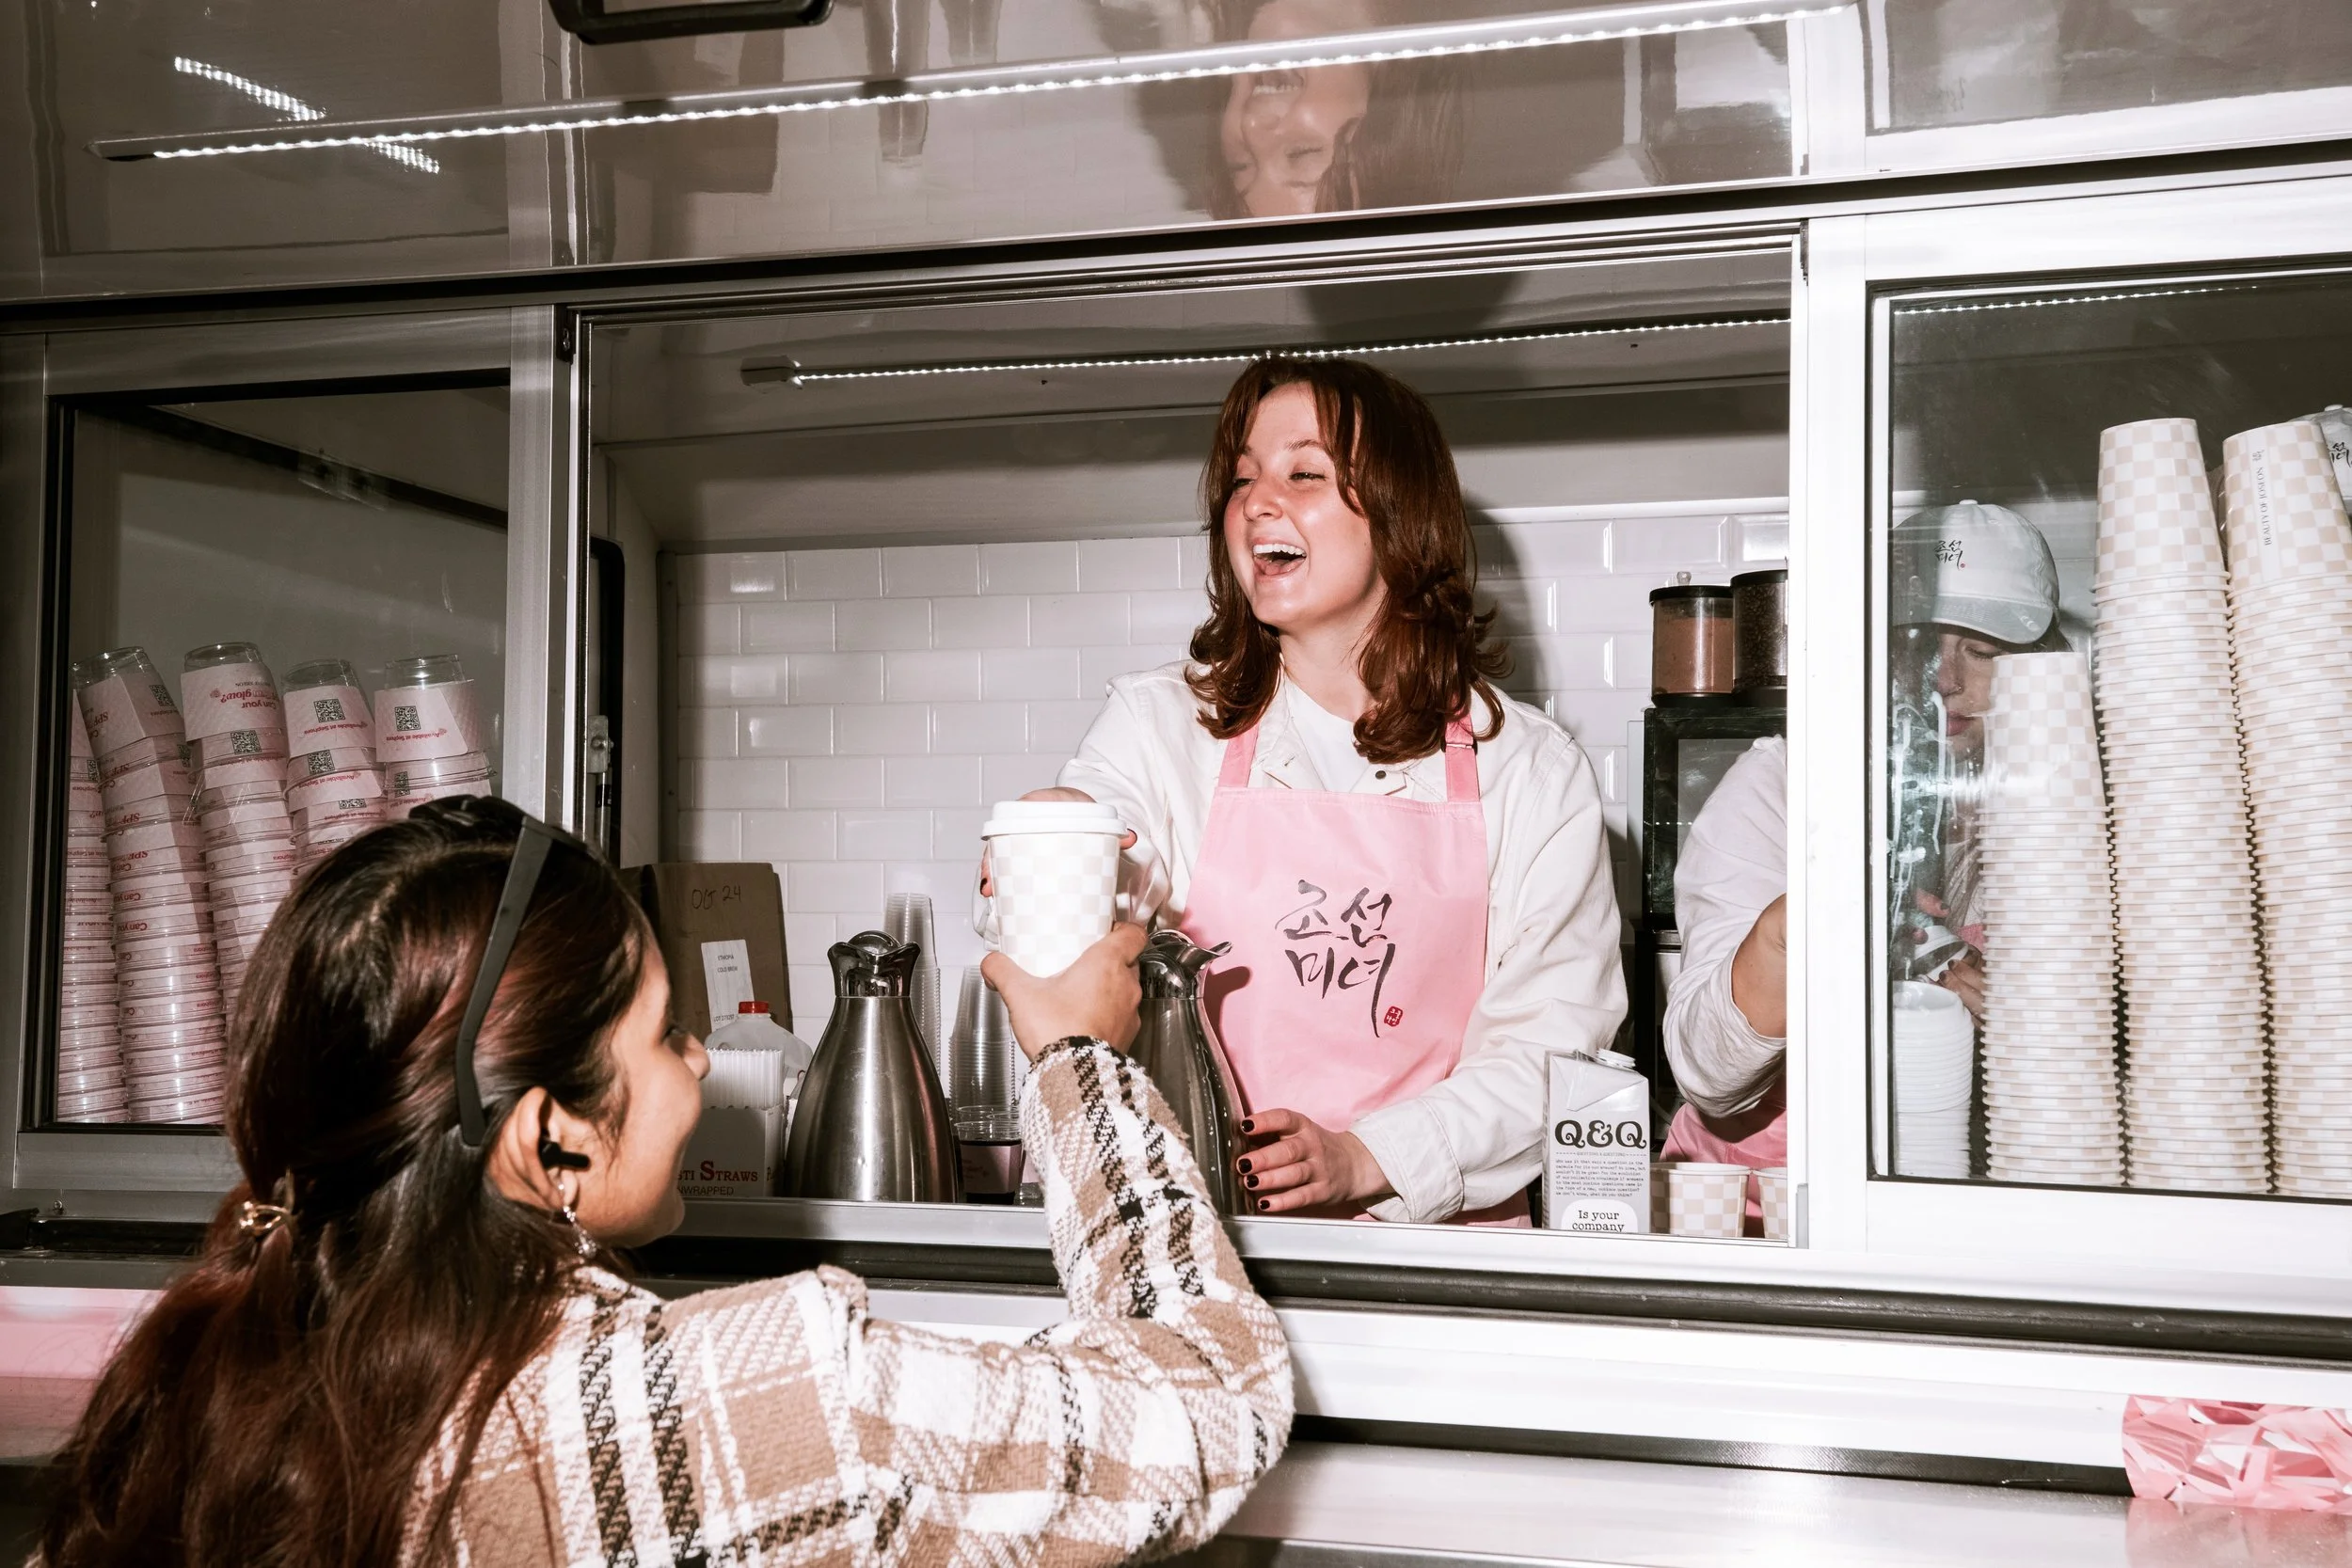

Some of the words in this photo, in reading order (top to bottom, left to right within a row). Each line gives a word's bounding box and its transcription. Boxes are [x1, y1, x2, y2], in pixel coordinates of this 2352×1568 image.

[2256, 467, 2267, 499] JOSEON
[2259, 502, 2268, 513] OF
[2261, 515, 2272, 546] BEAUTY
[1933, 539, 1962, 552] 조선
[220, 689, 252, 704] glow?
[241, 700, 263, 709] your
[304, 725, 329, 735] Sephora
[386, 734, 405, 742] Sephora
[410, 732, 440, 742] Available
[326, 774, 355, 783] Available
[124, 893, 141, 901] Can
[722, 885, 741, 902] 24
[1275, 879, 1392, 948] 조선
[130, 923, 148, 931] Can
[1284, 942, 1396, 1037] 미녀
[1555, 1119, 1647, 1149] Q&Q
[700, 1160, 758, 1181] STRAWS
[1578, 1210, 1589, 1220] Is
[1591, 1212, 1620, 1222] your
[1572, 1222, 1626, 1232] company
